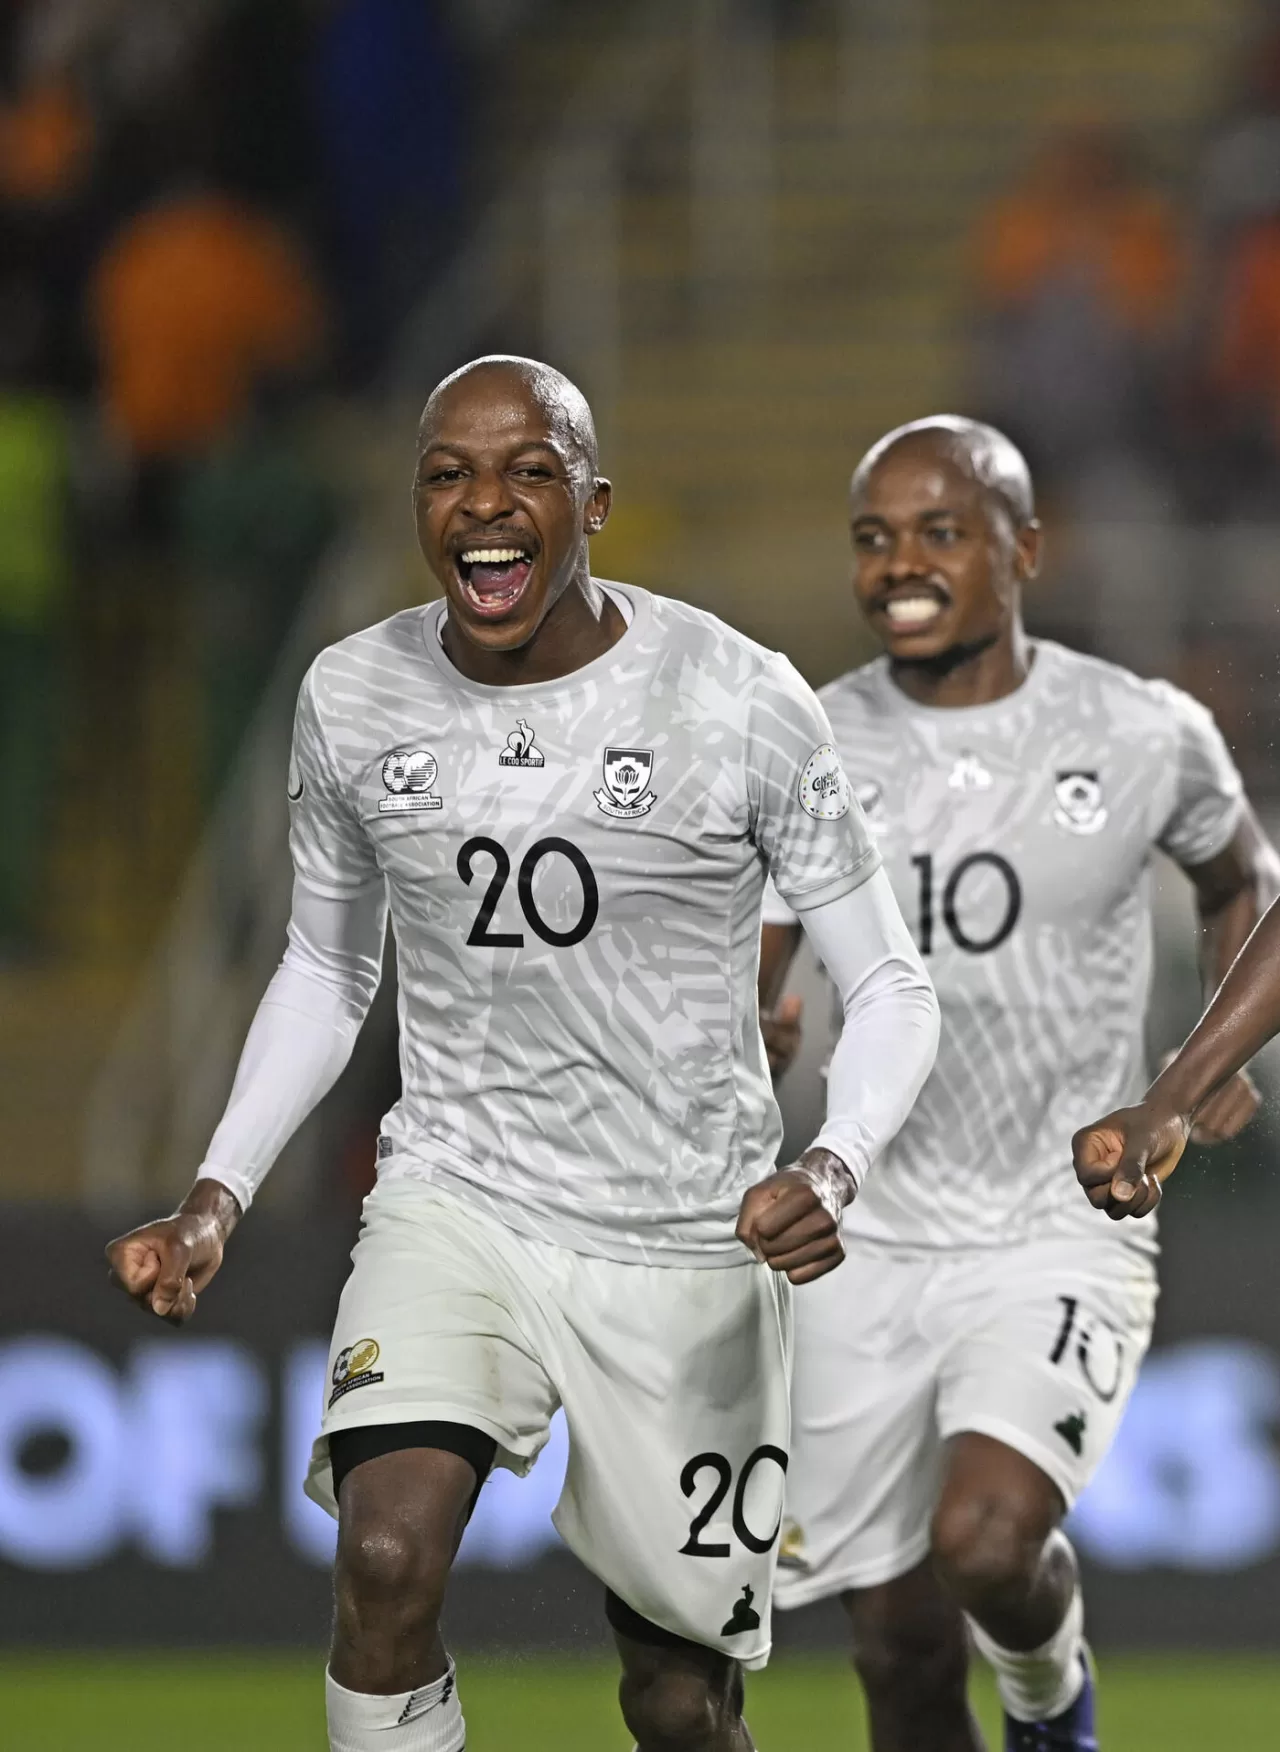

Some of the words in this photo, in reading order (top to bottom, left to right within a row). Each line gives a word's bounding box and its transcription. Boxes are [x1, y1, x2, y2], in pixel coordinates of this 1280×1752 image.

[603, 804, 623, 815] SOUTH
[623, 806, 647, 816] AFRICA
[457, 836, 599, 948] 20
[911, 852, 1021, 956] 10
[1050, 1296, 1123, 1405] 10
[678, 1444, 788, 1557] 20
